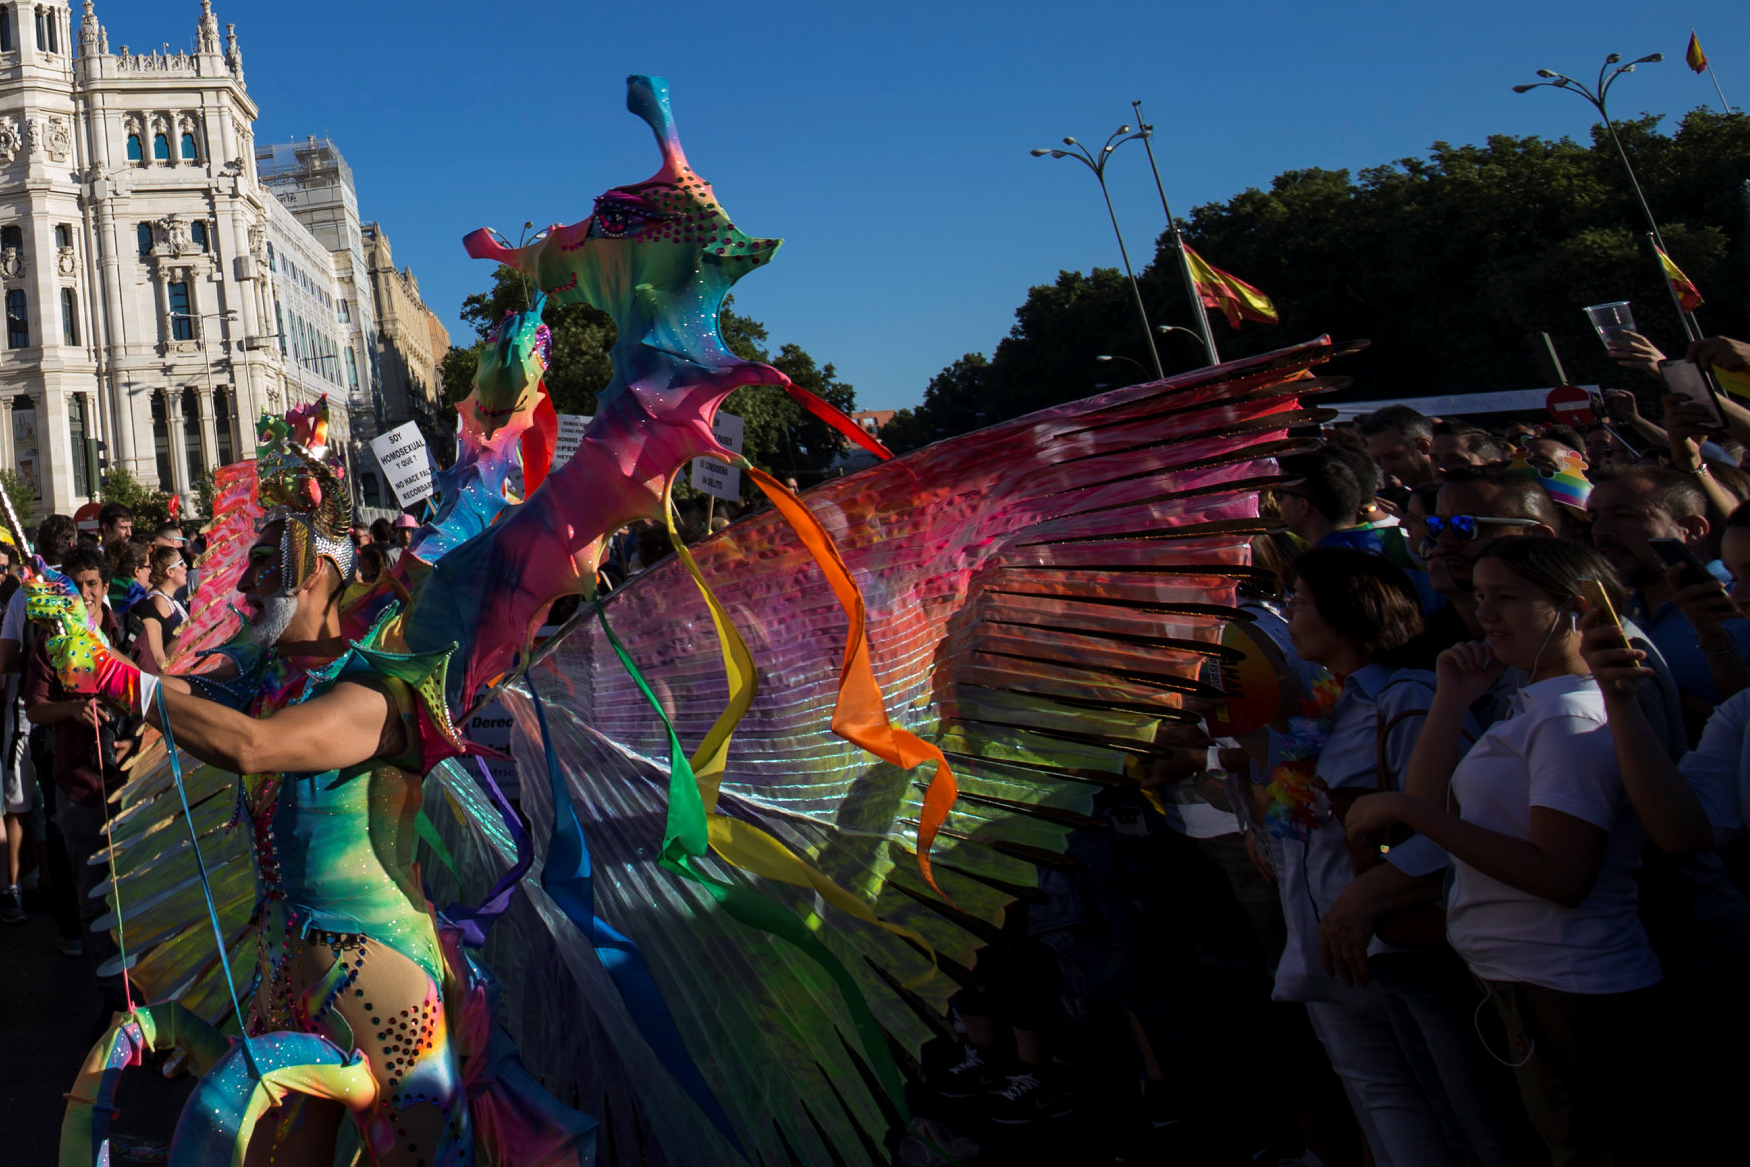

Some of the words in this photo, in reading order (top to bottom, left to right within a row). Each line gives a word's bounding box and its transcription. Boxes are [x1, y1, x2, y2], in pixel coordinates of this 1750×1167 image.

[388, 432, 402, 445] SOY
[380, 439, 425, 466] HOMOSEXUAL
[402, 455, 413, 467] QUE
[395, 481, 405, 490] NO
[405, 473, 419, 486] HACE
[419, 466, 436, 478] FALTA
